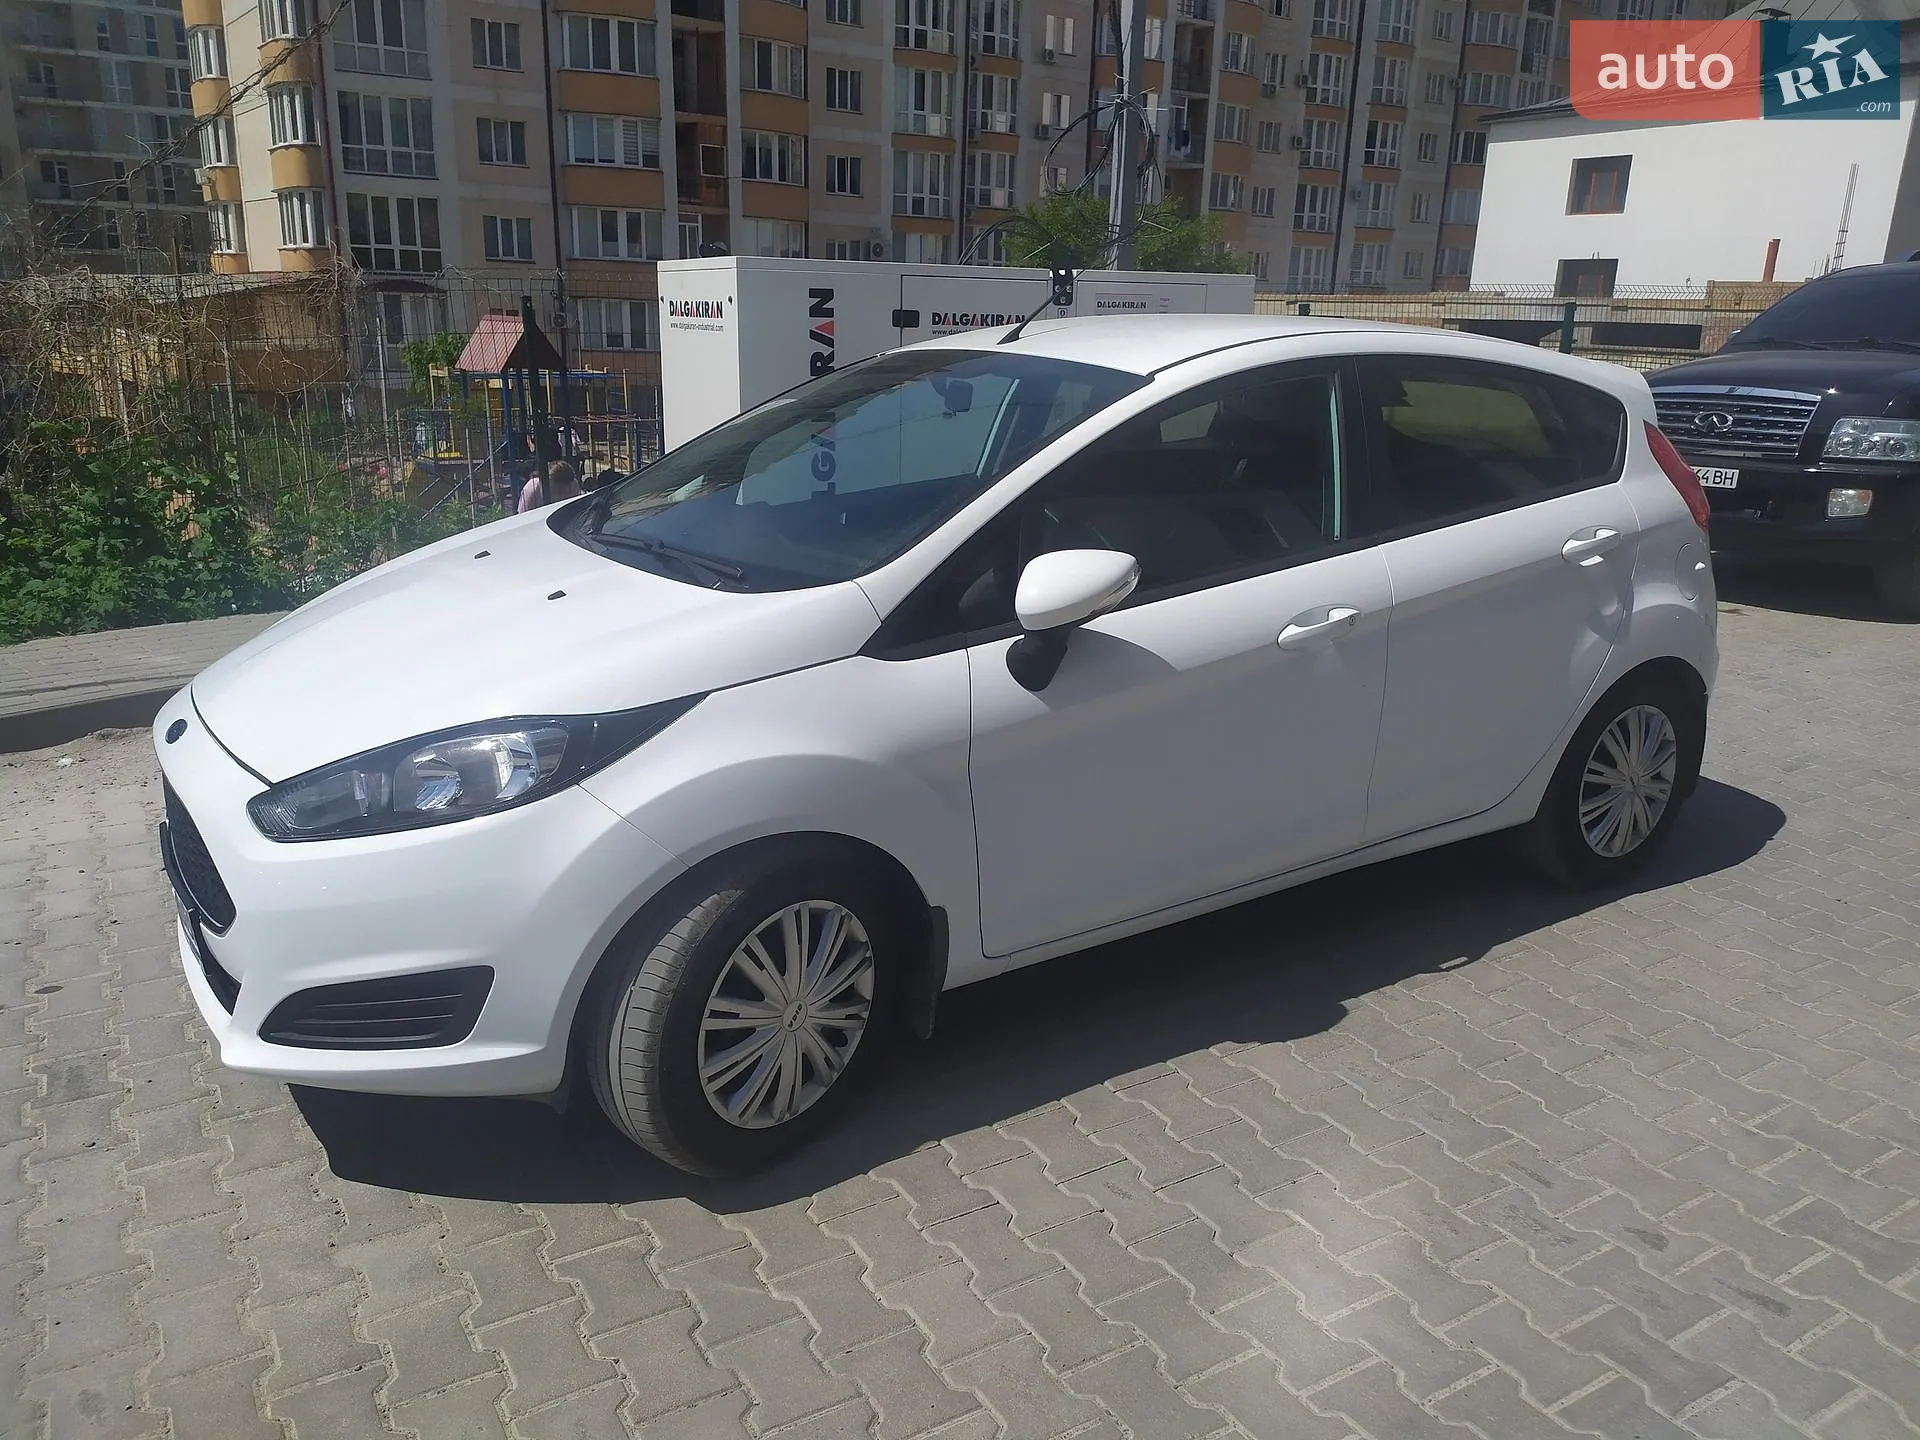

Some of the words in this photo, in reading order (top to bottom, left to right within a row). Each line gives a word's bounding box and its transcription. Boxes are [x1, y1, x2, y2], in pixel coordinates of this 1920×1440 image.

[669, 300, 724, 319] DALGAKIRAN
[1096, 301, 1147, 309] DALGAKIRAN
[931, 312, 1026, 327] DALGAKIRAN
[1713, 470, 1735, 486] BH
